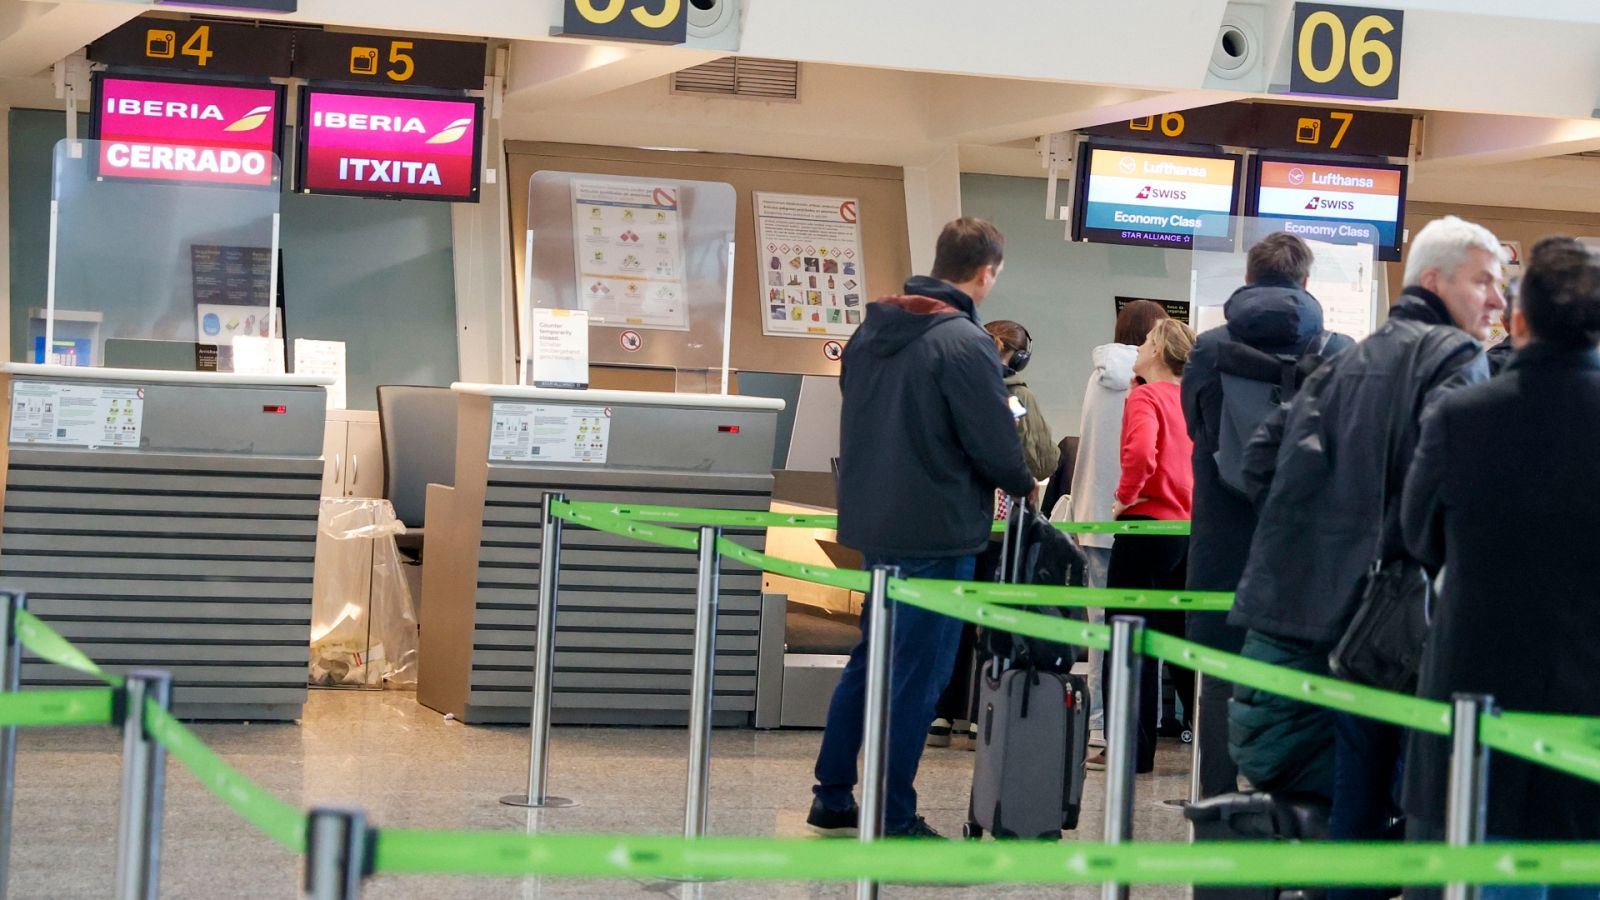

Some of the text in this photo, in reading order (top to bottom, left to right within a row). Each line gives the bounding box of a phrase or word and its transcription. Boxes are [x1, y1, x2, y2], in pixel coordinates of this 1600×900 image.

[181, 25, 214, 66] 4
[1299, 11, 1395, 87] 06
[386, 41, 415, 81] 5
[107, 97, 224, 121] IBERIA
[314, 111, 426, 134] IBERIA
[1160, 111, 1185, 137] 6
[1329, 112, 1355, 149] 7
[107, 143, 265, 176] CERRADO
[1143, 160, 1208, 178] Lufthansa
[338, 157, 442, 186] ITXITA
[1312, 171, 1374, 188] Lufthansa
[1152, 188, 1187, 201] SWISS
[1320, 199, 1355, 211] SWISS
[1114, 210, 1202, 229] Economy Class
[1285, 221, 1370, 239] Economy Class
[1121, 231, 1182, 242] STAR ALLIANCE
